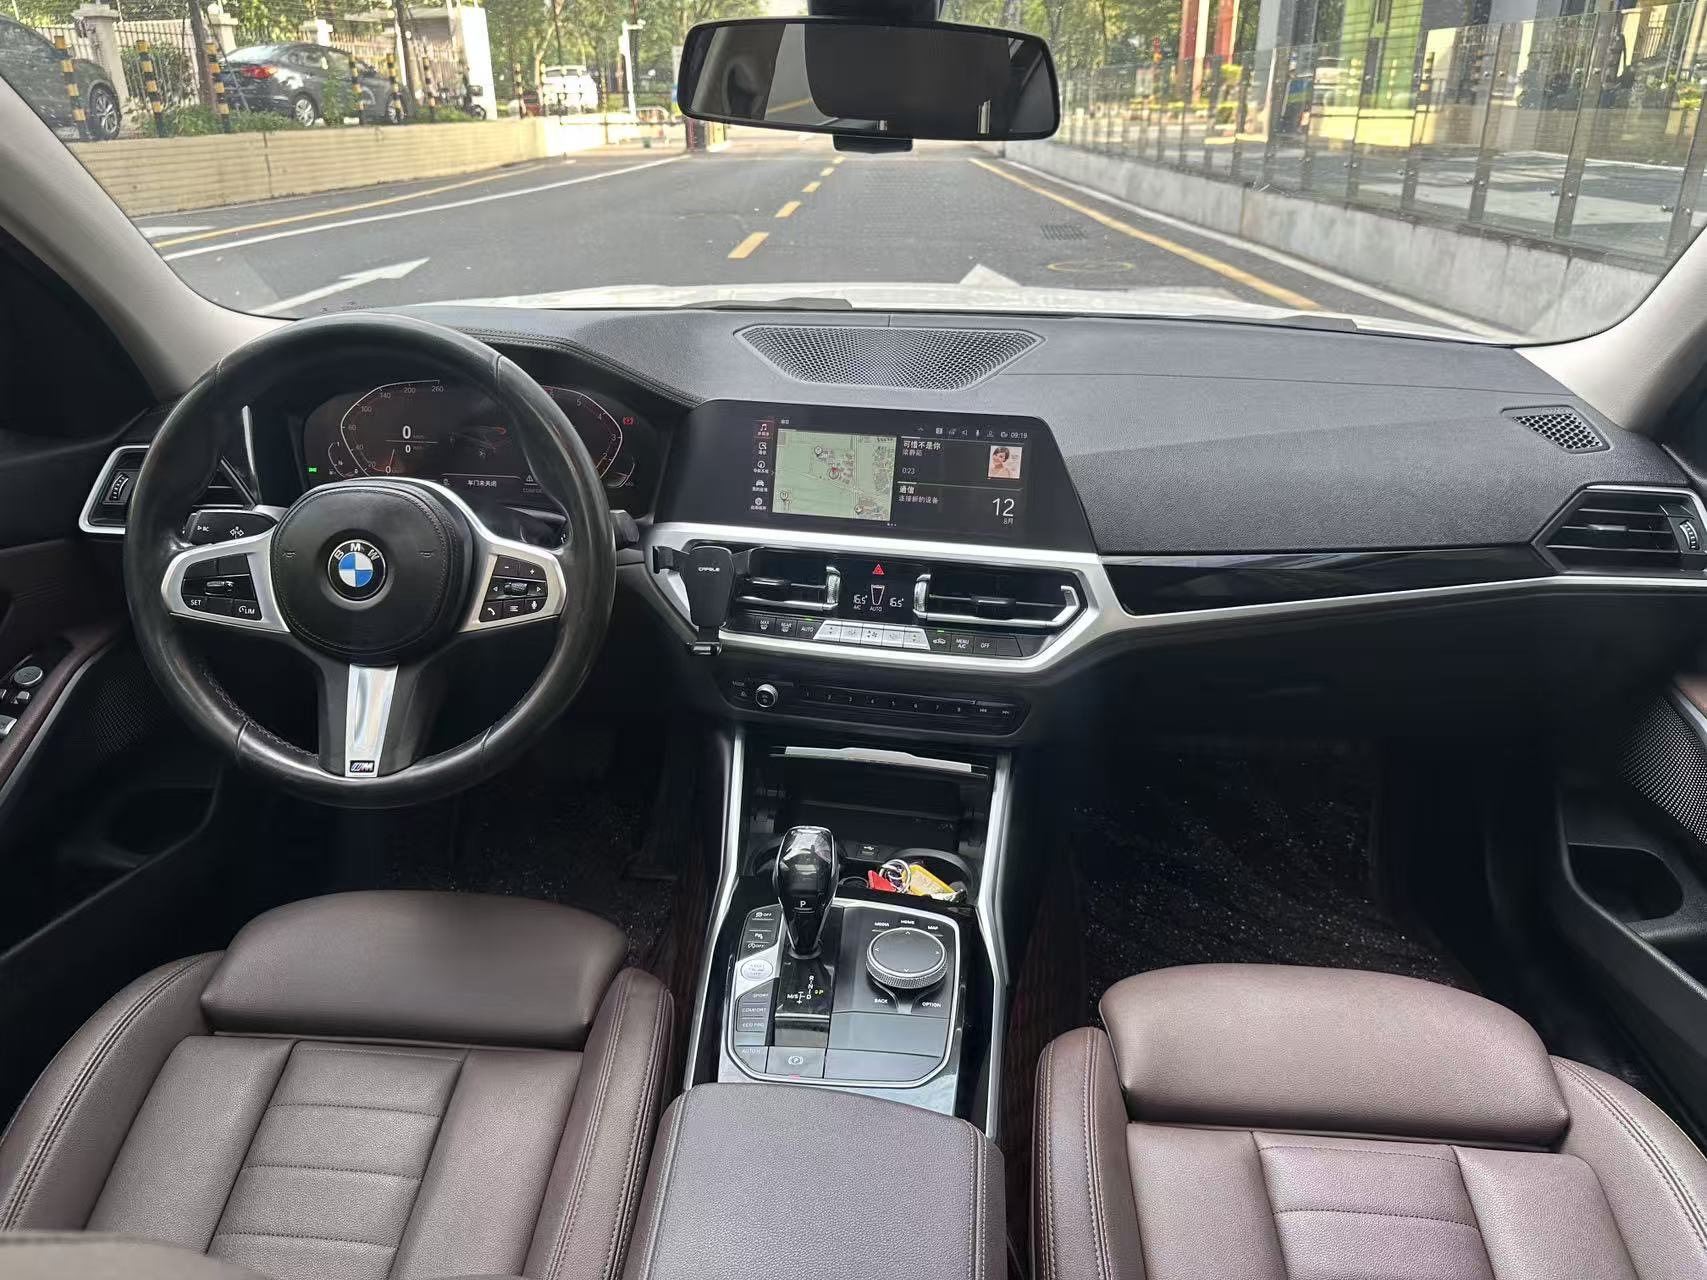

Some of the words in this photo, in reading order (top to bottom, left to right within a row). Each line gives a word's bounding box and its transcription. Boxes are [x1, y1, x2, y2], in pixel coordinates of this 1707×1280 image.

[402, 425, 412, 440] 0
[405, 444, 411, 454] 0
[385, 466, 392, 474] 0
[992, 498, 1015, 517] 12
[334, 542, 380, 560] BMW
